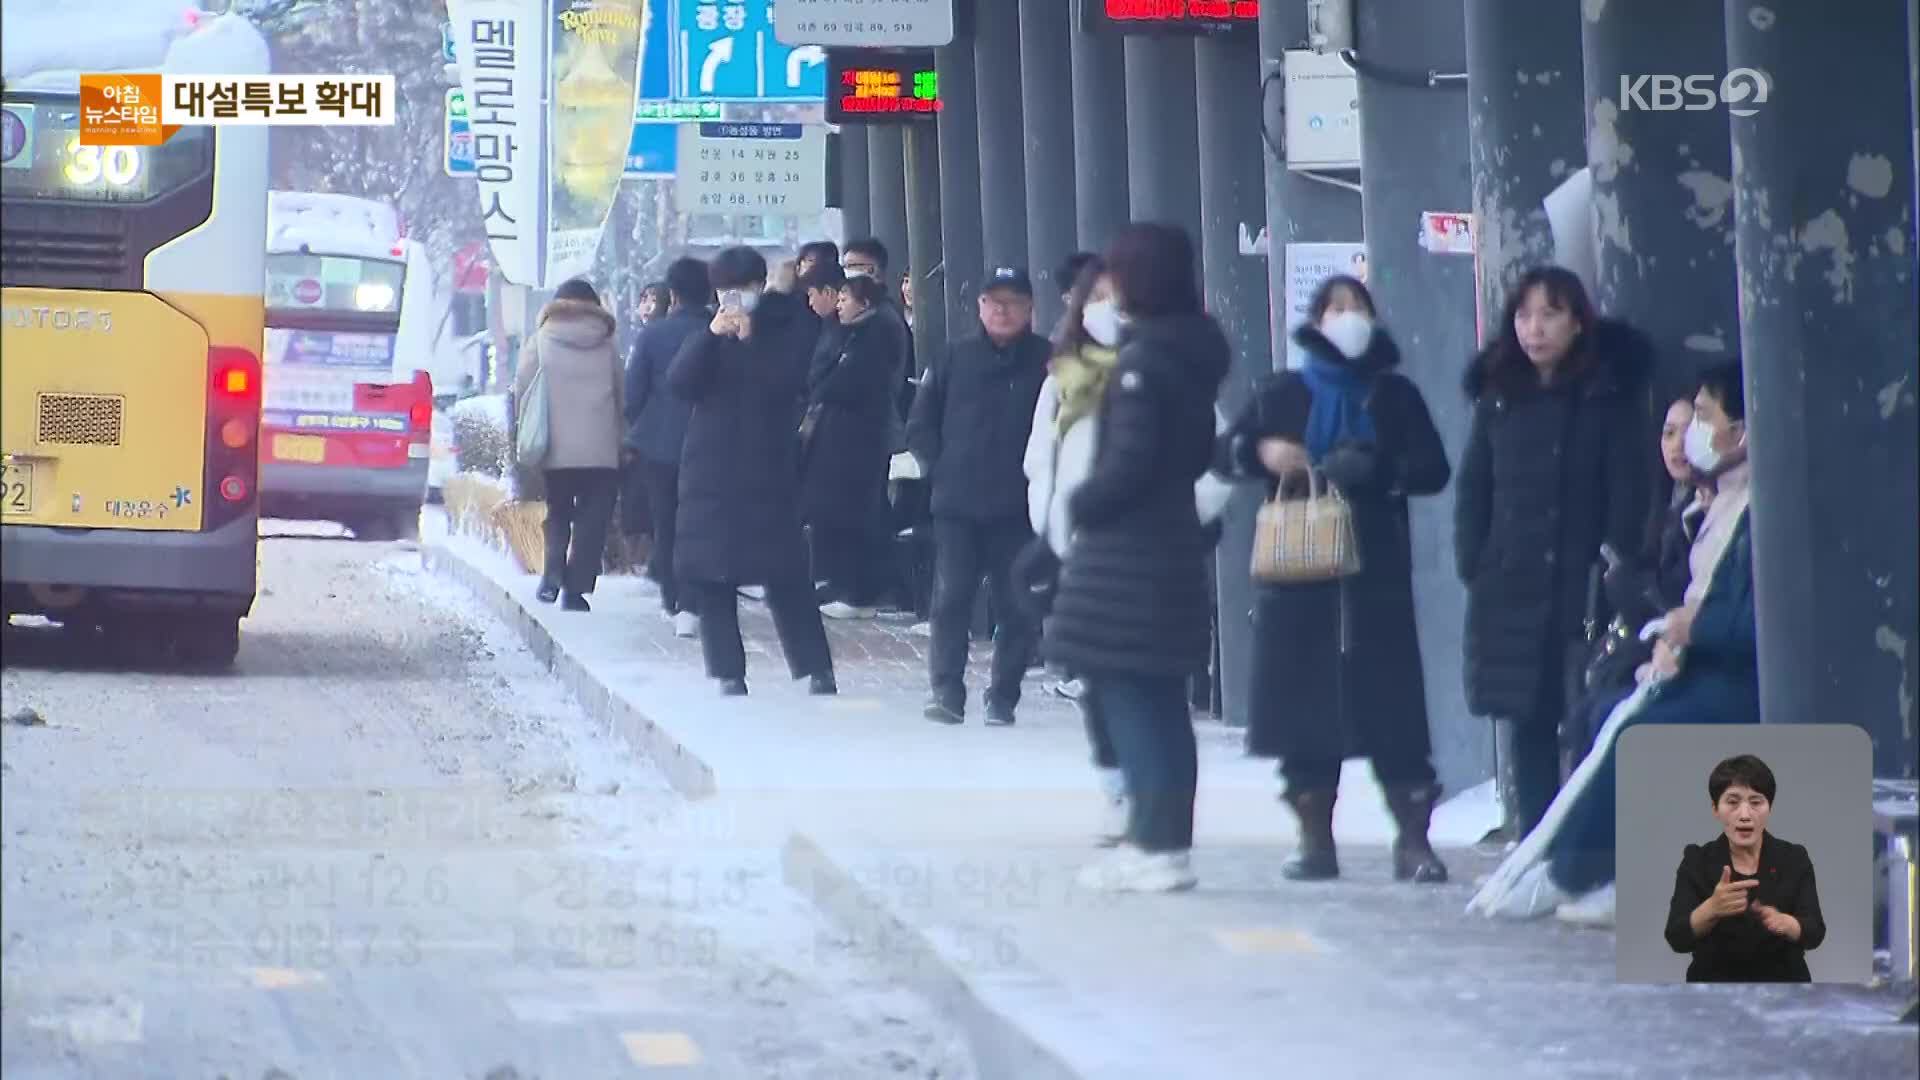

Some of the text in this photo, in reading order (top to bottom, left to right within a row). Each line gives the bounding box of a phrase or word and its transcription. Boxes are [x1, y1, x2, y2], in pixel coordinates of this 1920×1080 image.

[472, 20, 518, 240] 멜로망스
[785, 150, 801, 161] 25
[63, 134, 140, 185] 30
